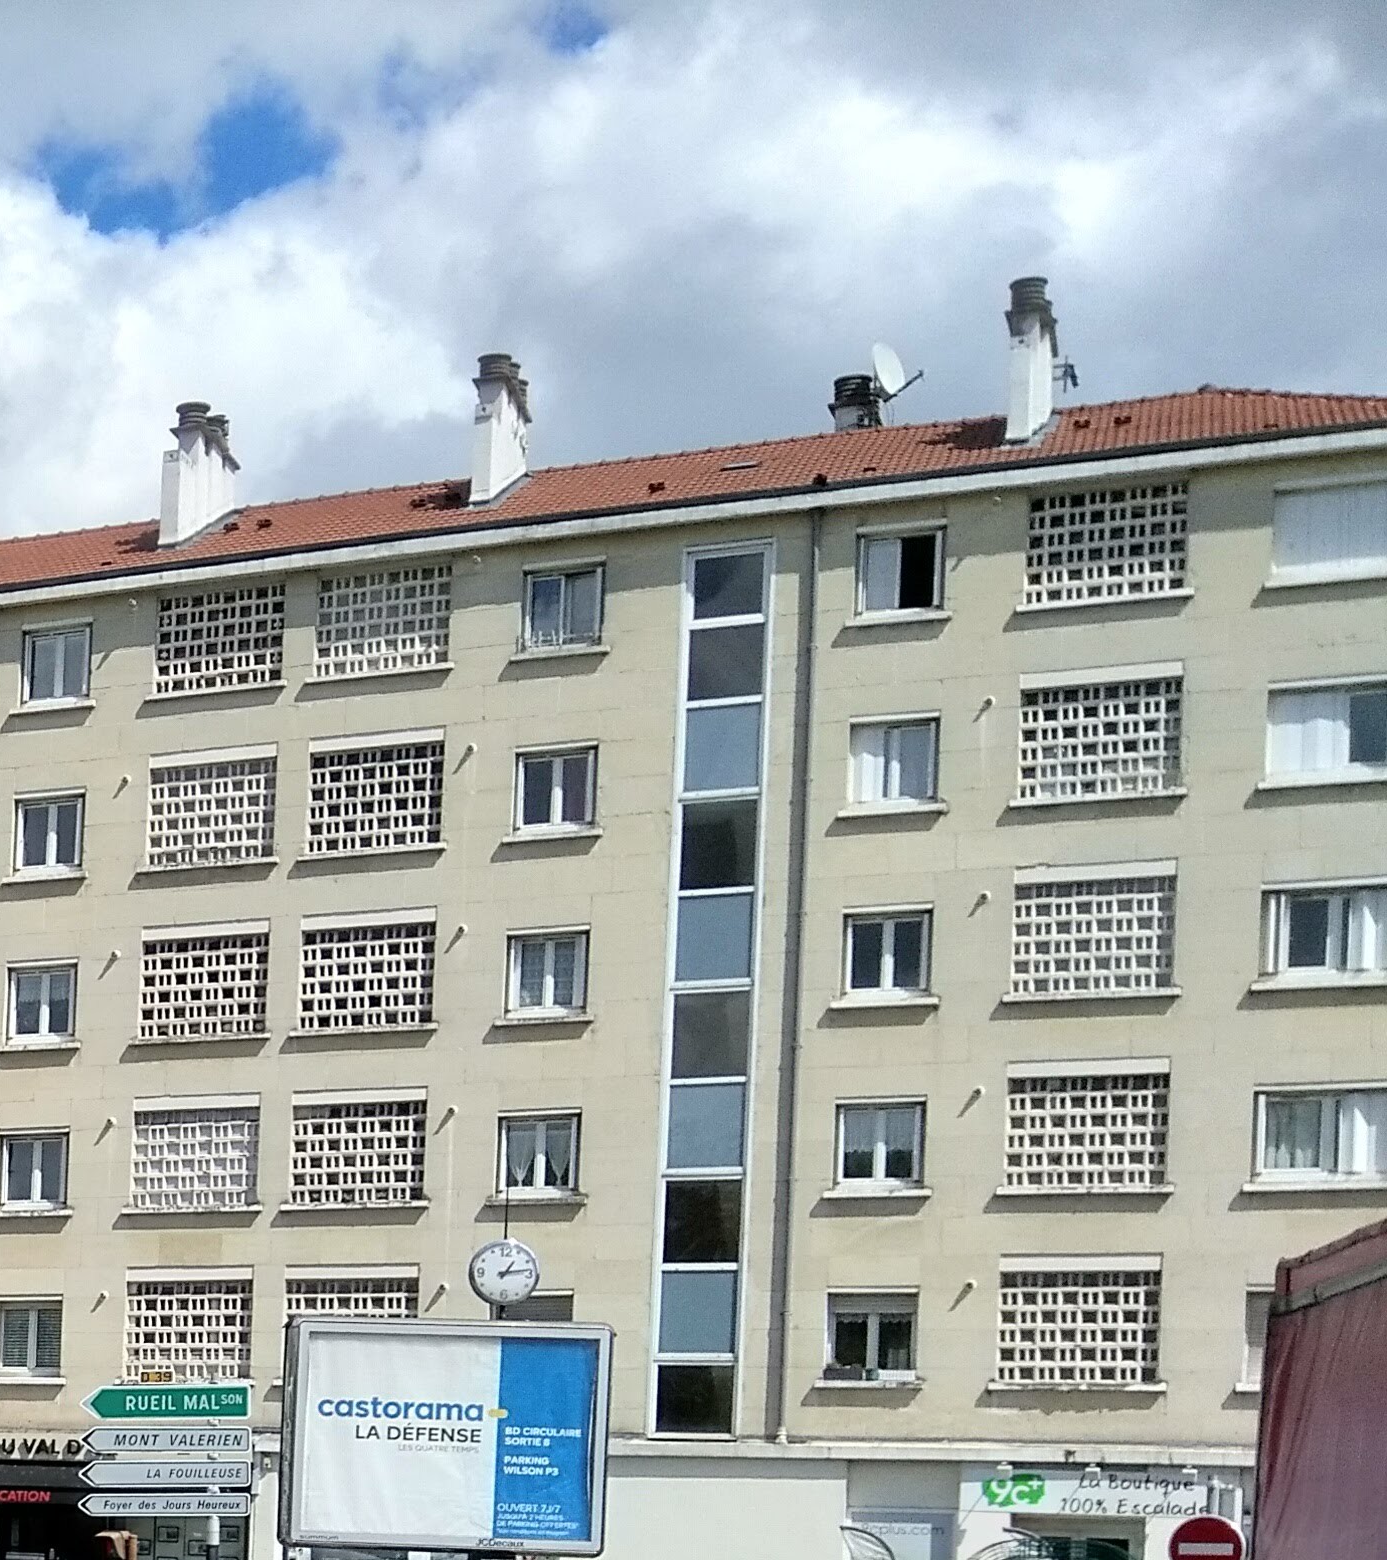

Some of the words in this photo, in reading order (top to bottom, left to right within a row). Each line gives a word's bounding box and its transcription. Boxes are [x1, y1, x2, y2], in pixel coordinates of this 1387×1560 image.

[499, 1247, 513, 1258] 12
[476, 1267, 485, 1278] 9
[525, 1268, 533, 1279] 3
[499, 1289, 508, 1300] 6
[140, 1372, 150, 1382] D
[155, 1371, 173, 1382] 39
[125, 1395, 176, 1411] RUEIL
[317, 1396, 484, 1422] castorama
[355, 1425, 380, 1440] LA
[387, 1422, 482, 1443] DÉFENSE
[504, 1426, 521, 1436] BD
[522, 1427, 582, 1438] CIRCULAIRE
[113, 1434, 160, 1446] MONT
[170, 1434, 244, 1446] VALERIEN
[504, 1437, 542, 1447] SORTIE
[23, 1439, 60, 1455] VAL
[503, 1456, 549, 1466] PARKING
[146, 1468, 161, 1479] LA
[169, 1468, 242, 1479] FOUILLEUSE
[503, 1466, 543, 1476] WILSON
[545, 1467, 559, 1477] P3
[1079, 1473, 1101, 1489] La
[1108, 1473, 1196, 1498] Boutique
[103, 1500, 132, 1513] Foyer
[138, 1500, 156, 1510] des
[162, 1499, 191, 1510] Jours
[197, 1499, 241, 1510] Heureux
[497, 1503, 538, 1513] OUVERT
[1061, 1498, 1108, 1514] 100%
